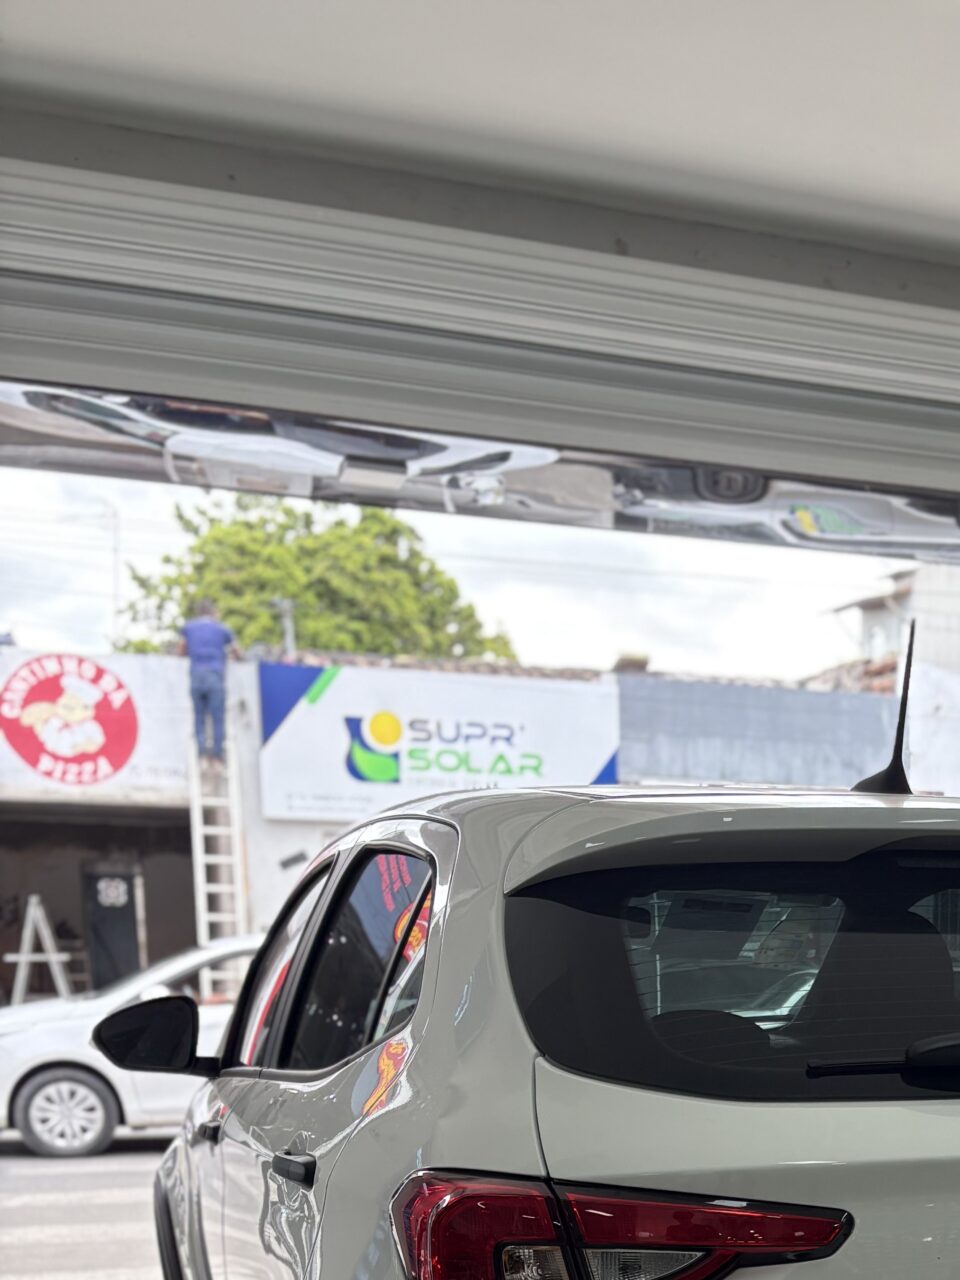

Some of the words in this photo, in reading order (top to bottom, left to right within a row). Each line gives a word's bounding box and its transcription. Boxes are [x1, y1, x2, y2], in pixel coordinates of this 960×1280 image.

[100, 671, 129, 710] DA
[36, 752, 115, 784] PIZZA
[407, 747, 544, 776] SOLAR
